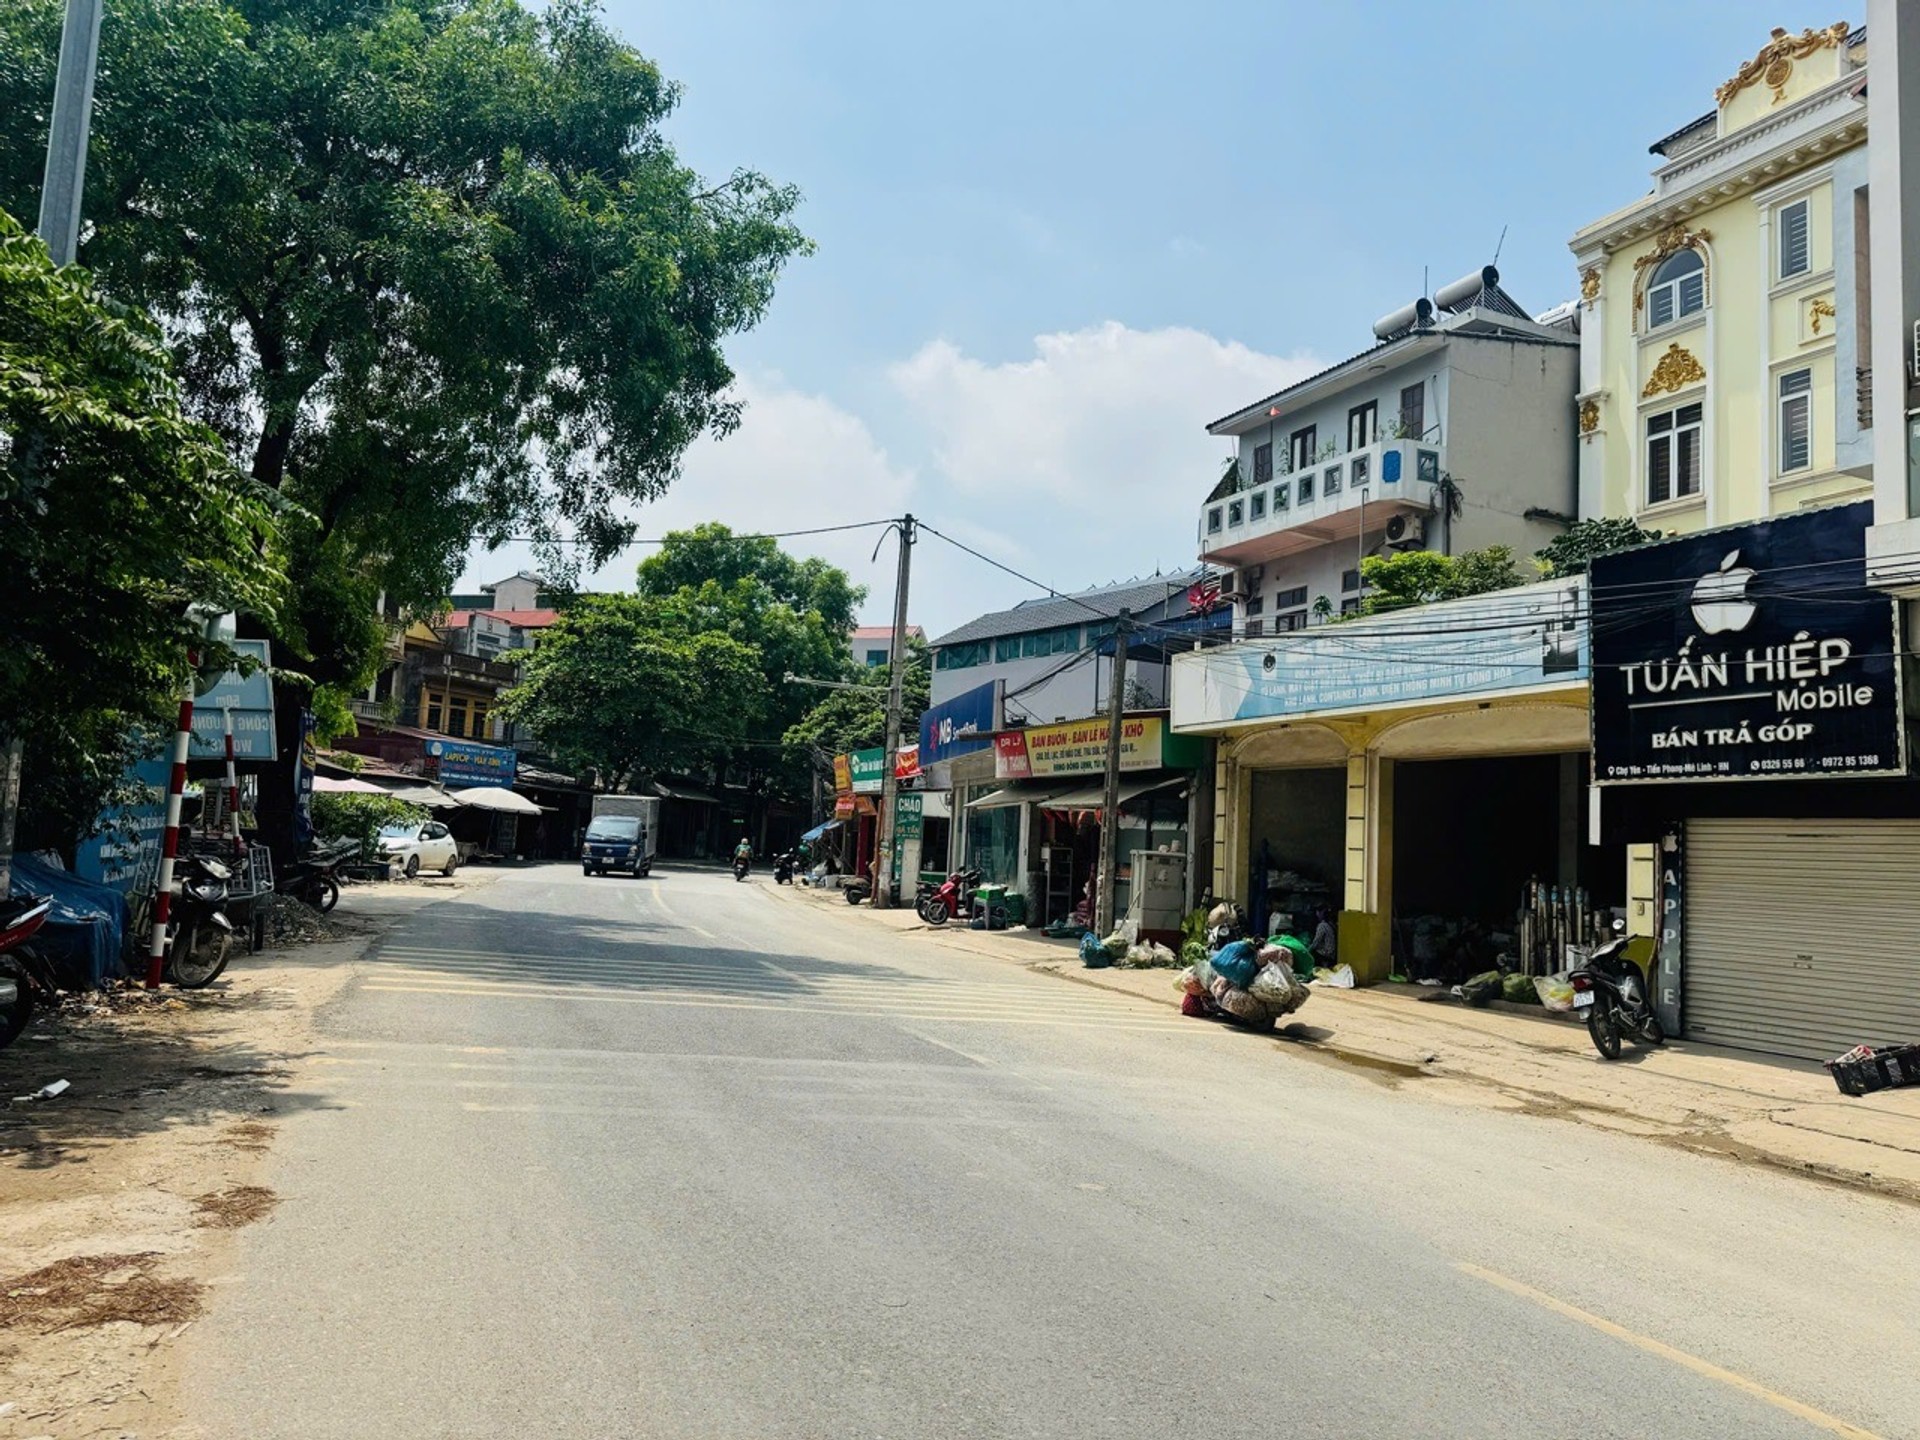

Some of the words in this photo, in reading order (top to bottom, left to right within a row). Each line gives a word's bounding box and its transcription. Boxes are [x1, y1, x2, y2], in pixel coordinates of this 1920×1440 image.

[1619, 634, 1729, 695] TUẤN
[1745, 630, 1852, 688] HIỆP
[1777, 683, 1875, 712] Mobile
[1651, 725, 1699, 749] BÁN
[1704, 719, 1753, 745] TRẢ
[1758, 717, 1815, 742] GÓP
[1782, 759, 1793, 769] 55
[1822, 756, 1843, 767] 0972
[1845, 756, 1856, 766] 95
